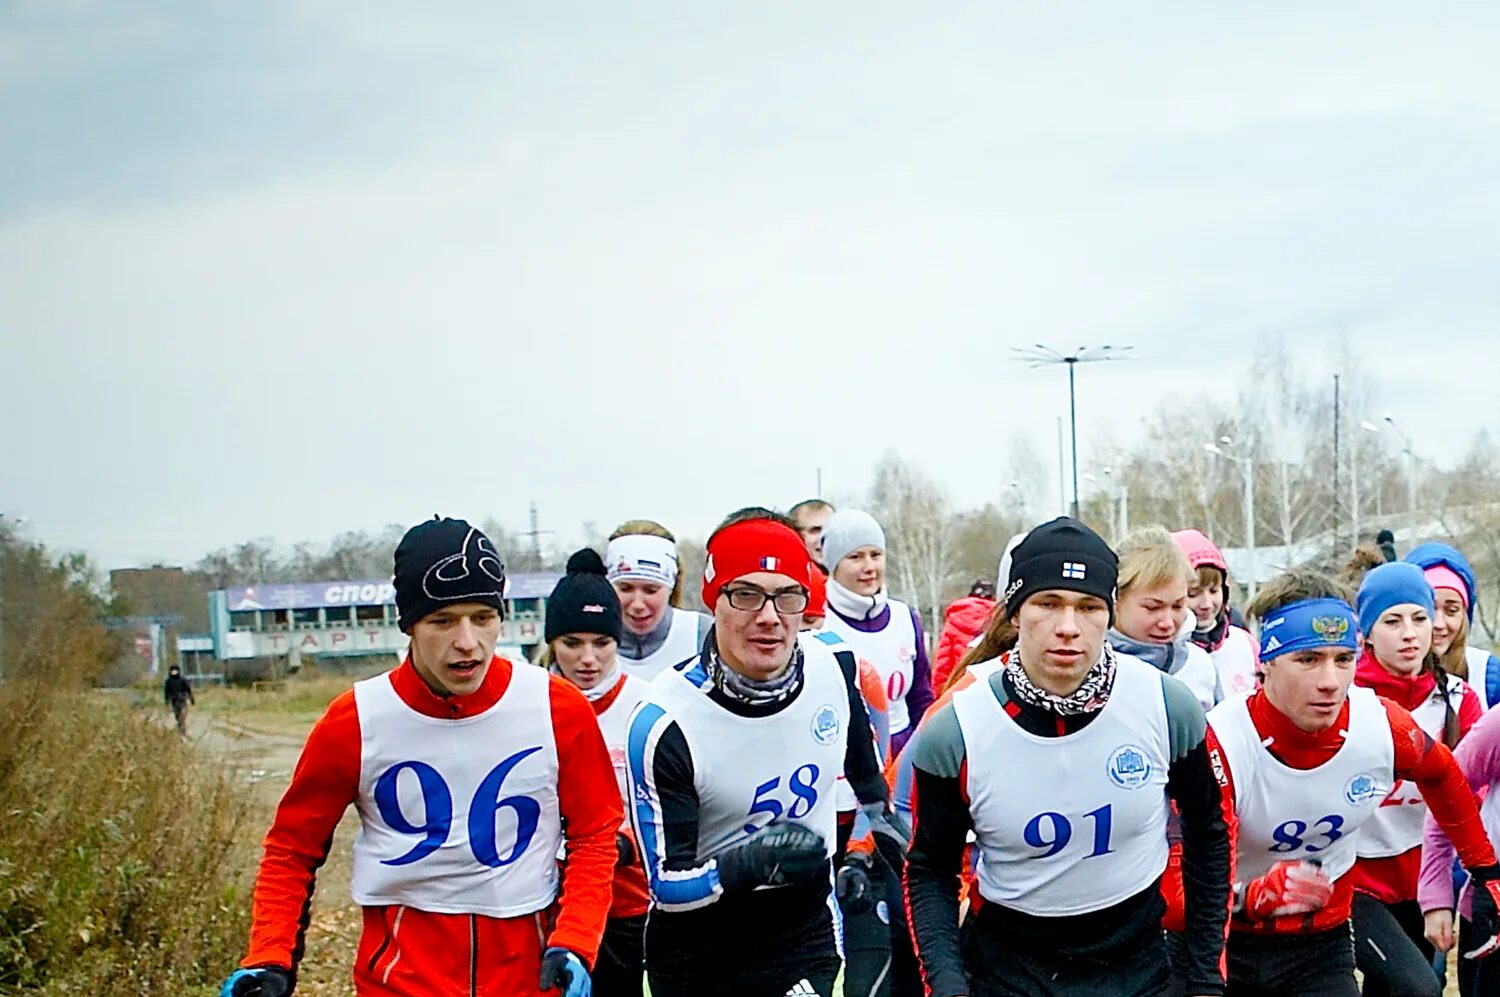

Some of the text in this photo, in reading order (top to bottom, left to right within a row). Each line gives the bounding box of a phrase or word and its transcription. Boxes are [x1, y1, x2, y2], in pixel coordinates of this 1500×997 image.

[325, 583, 396, 605] спор
[374, 746, 543, 868] 96
[743, 763, 820, 835] 58
[1023, 803, 1116, 860] 91
[1268, 814, 1345, 853] 83
